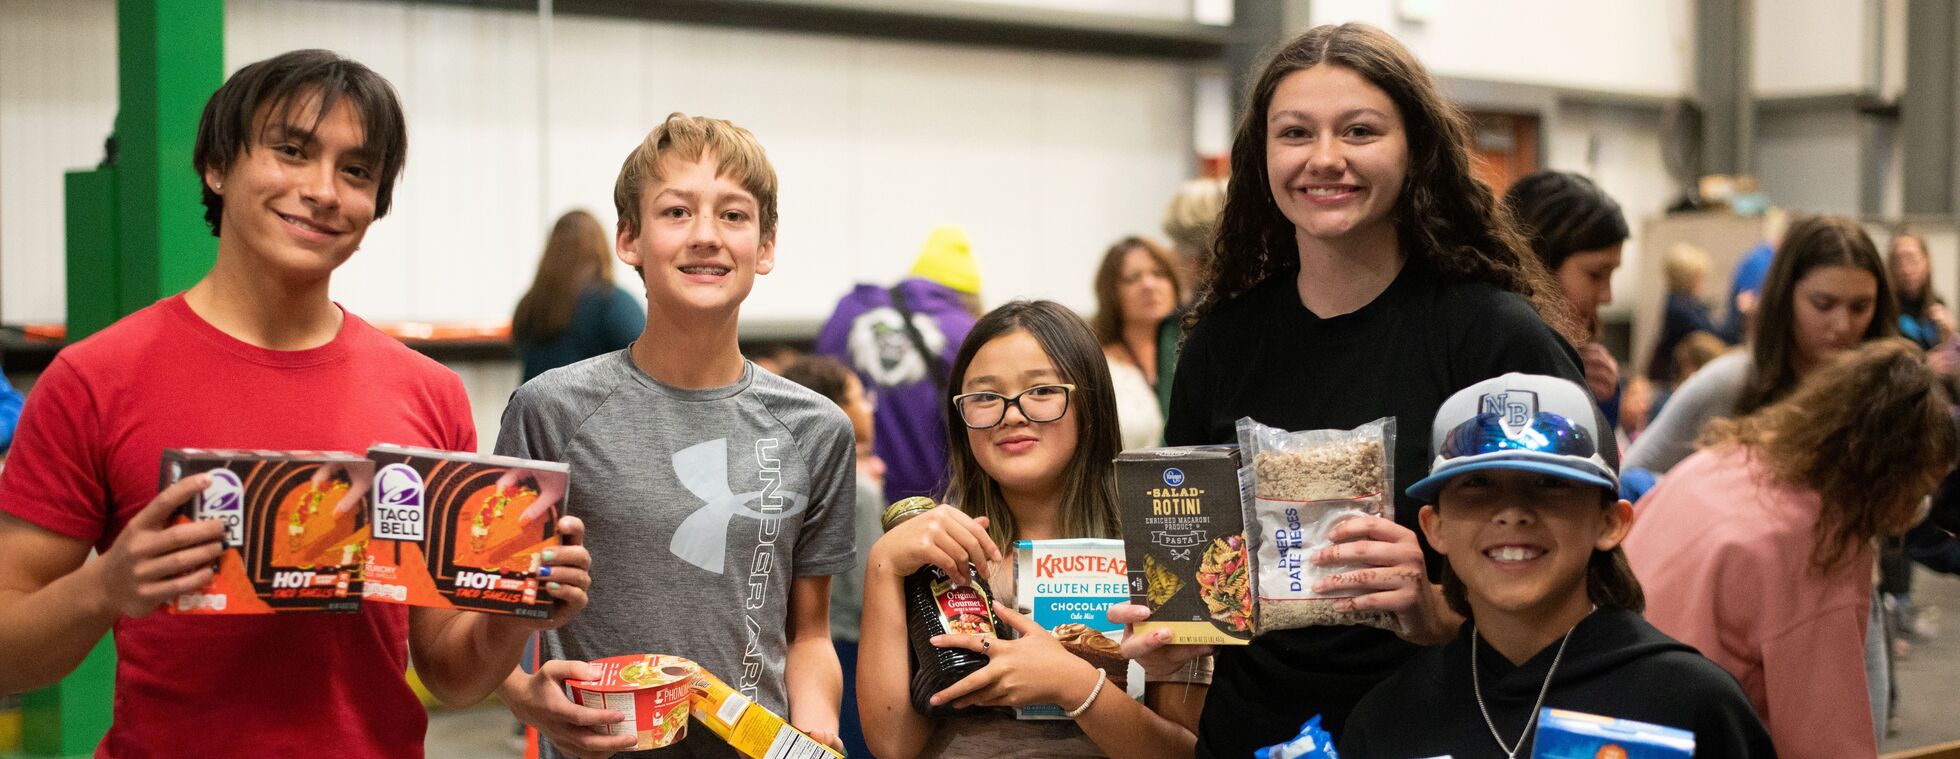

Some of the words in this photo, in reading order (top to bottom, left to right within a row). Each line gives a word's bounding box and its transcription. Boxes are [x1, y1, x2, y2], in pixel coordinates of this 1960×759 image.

[1485, 393, 1528, 427] NB
[377, 507, 421, 522] TACO
[1153, 499, 1201, 516] ROTINI
[747, 438, 784, 609] UNDER
[1145, 517, 1176, 525] ENRICHED
[1178, 516, 1210, 524] MACARONI
[1165, 523, 1193, 531] PRODUCT
[381, 521, 421, 536] BELL
[1166, 537, 1193, 545] PASTA
[365, 564, 396, 574] RUNCHY
[1289, 553, 1302, 592] DATE
[272, 571, 317, 589] HOT
[455, 571, 502, 590] HOT
[455, 588, 481, 598] TACO
[482, 590, 522, 603] SHELLS
[946, 590, 977, 601] Original
[1036, 583, 1089, 594] GLUTEN
[1095, 583, 1129, 594] FREE
[948, 599, 981, 609] Gourmet
